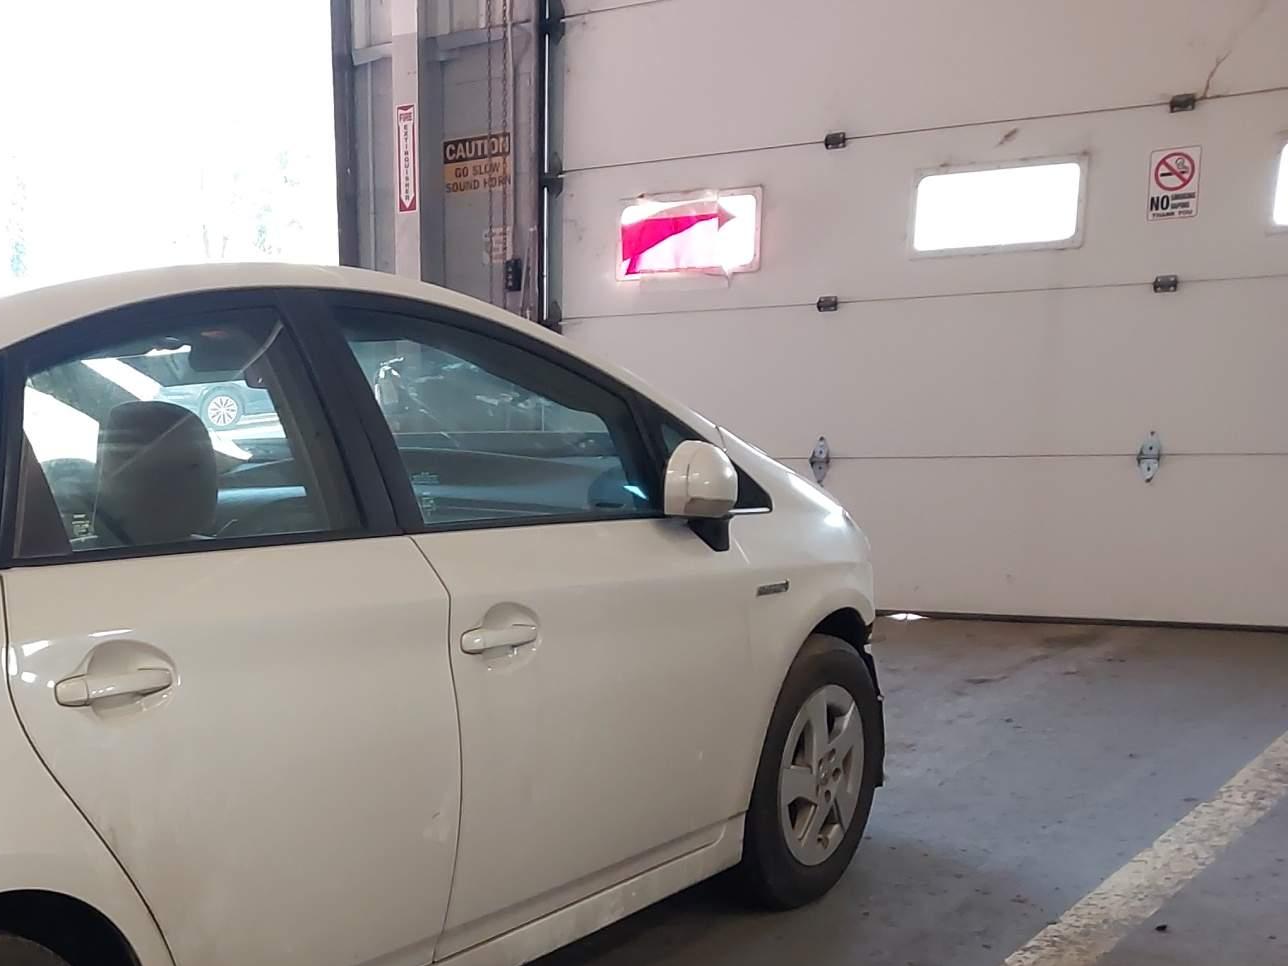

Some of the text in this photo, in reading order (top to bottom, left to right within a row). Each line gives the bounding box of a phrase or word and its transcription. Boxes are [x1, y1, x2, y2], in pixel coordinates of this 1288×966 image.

[445, 135, 510, 160] CAUTION
[454, 162, 500, 178] GO SLOW
[445, 175, 511, 193] SOUND HORN
[1150, 195, 1170, 211] NO
